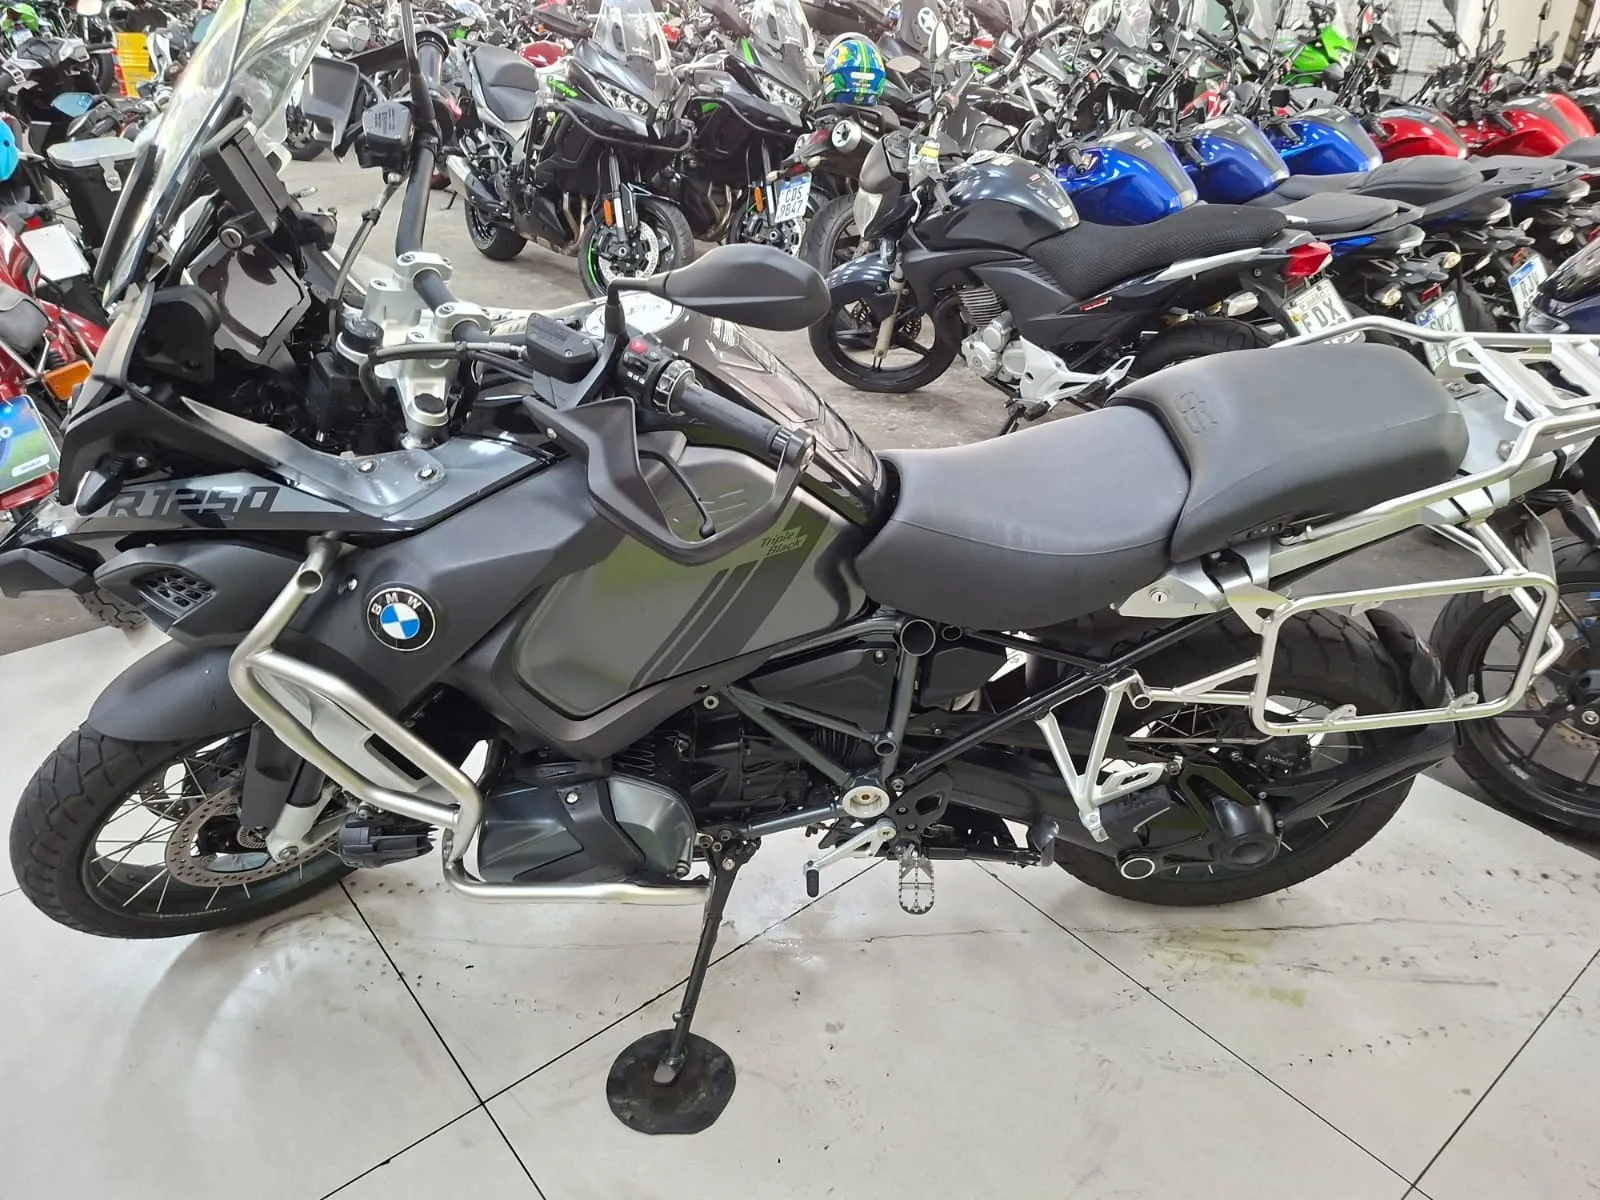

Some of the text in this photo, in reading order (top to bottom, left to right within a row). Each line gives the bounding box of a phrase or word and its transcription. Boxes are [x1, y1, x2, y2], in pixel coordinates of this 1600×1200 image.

[1301, 297, 1341, 333] FDX
[107, 486, 281, 517] R1250
[761, 531, 795, 548] Triple
[767, 538, 801, 556] Black
[371, 592, 422, 615] BMW
